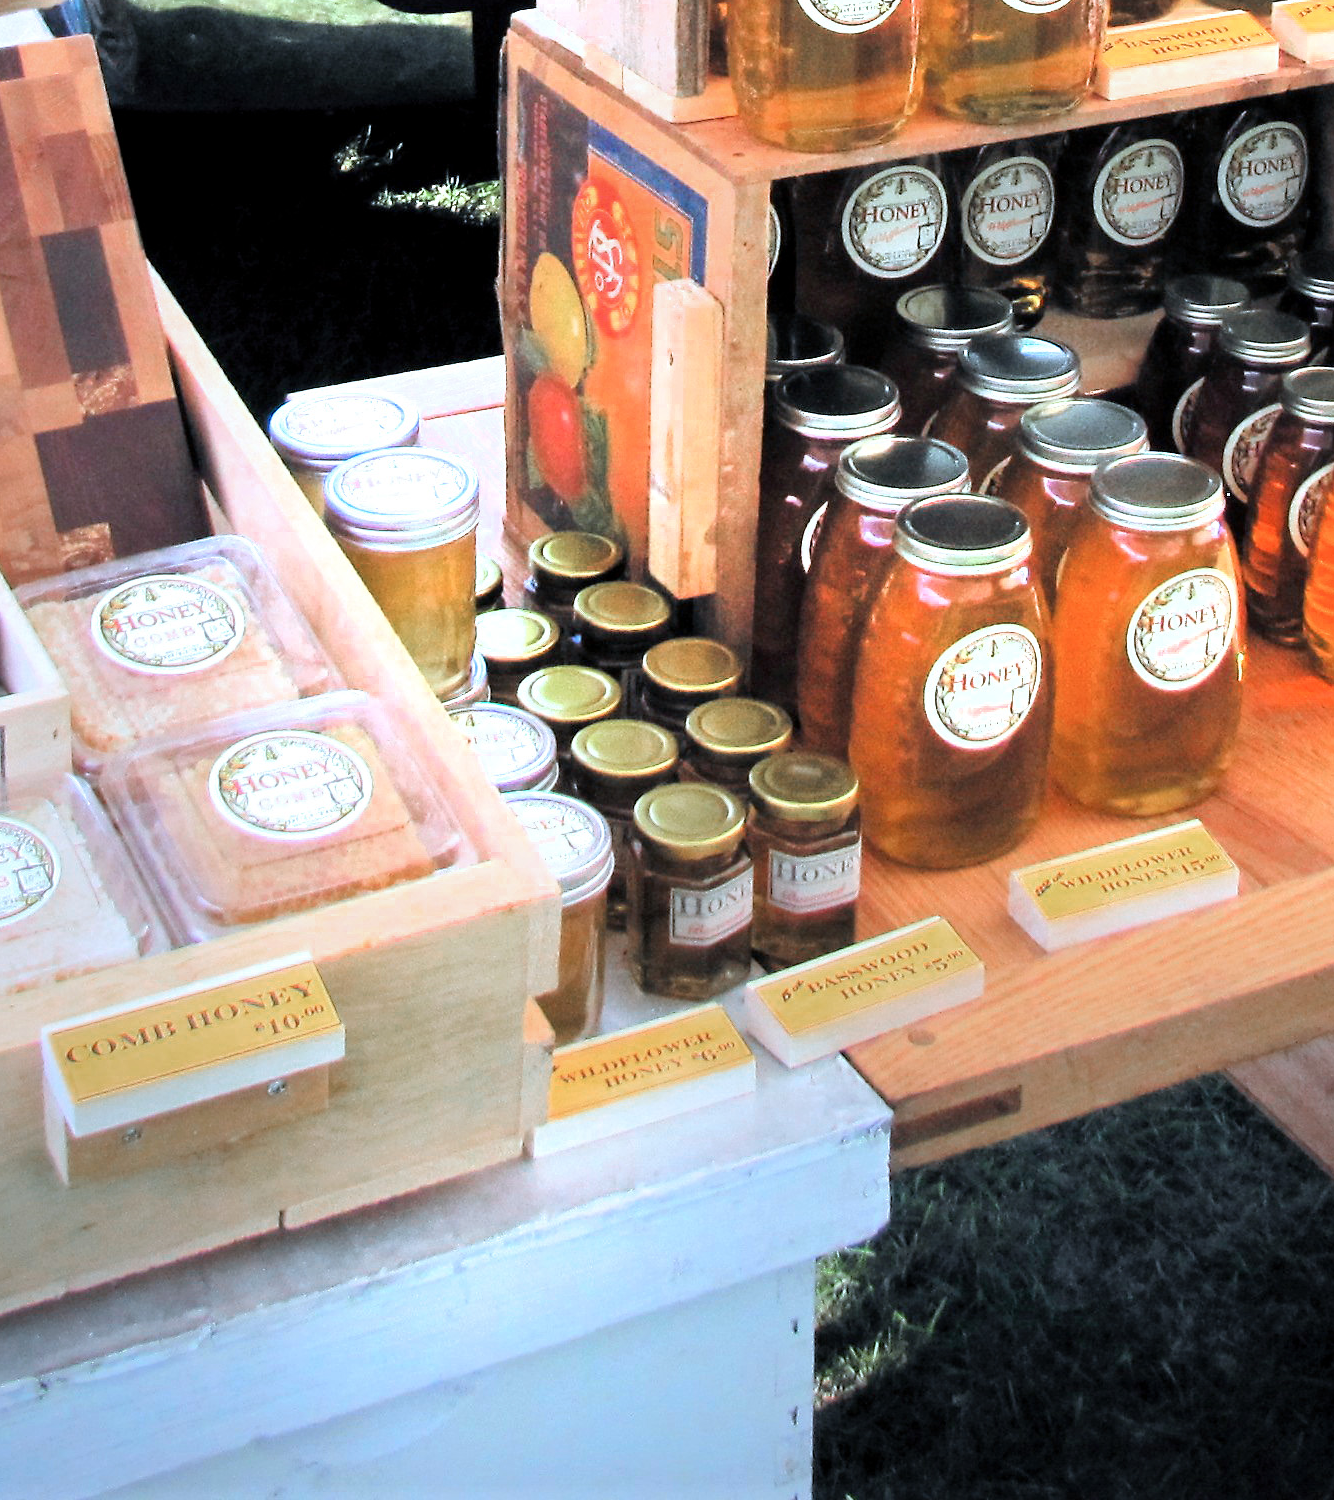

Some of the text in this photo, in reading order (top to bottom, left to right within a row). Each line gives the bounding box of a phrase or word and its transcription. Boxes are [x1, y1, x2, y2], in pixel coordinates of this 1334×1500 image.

[1123, 25, 1230, 50] BASSWOOD
[1152, 39, 1219, 56] HONEY
[1240, 158, 1297, 178] HONEY
[1115, 176, 1173, 195] HONEY
[860, 202, 930, 225] HONEY
[979, 190, 1043, 215] HONEY
[112, 599, 207, 633] HONEY
[1148, 602, 1220, 634] HONEY
[133, 625, 197, 649] COMB
[949, 660, 1026, 694] HONEY
[231, 756, 333, 796] HONEY
[1059, 846, 1194, 891] WILDFLOWER
[1100, 869, 1171, 893] HONEY
[806, 940, 930, 996] BASSWOOD
[840, 965, 918, 1000] HONEY
[65, 978, 313, 1064] COMB HONEY
[559, 1031, 714, 1086] WILDFLOWER
[603, 1055, 684, 1090] HONEY
